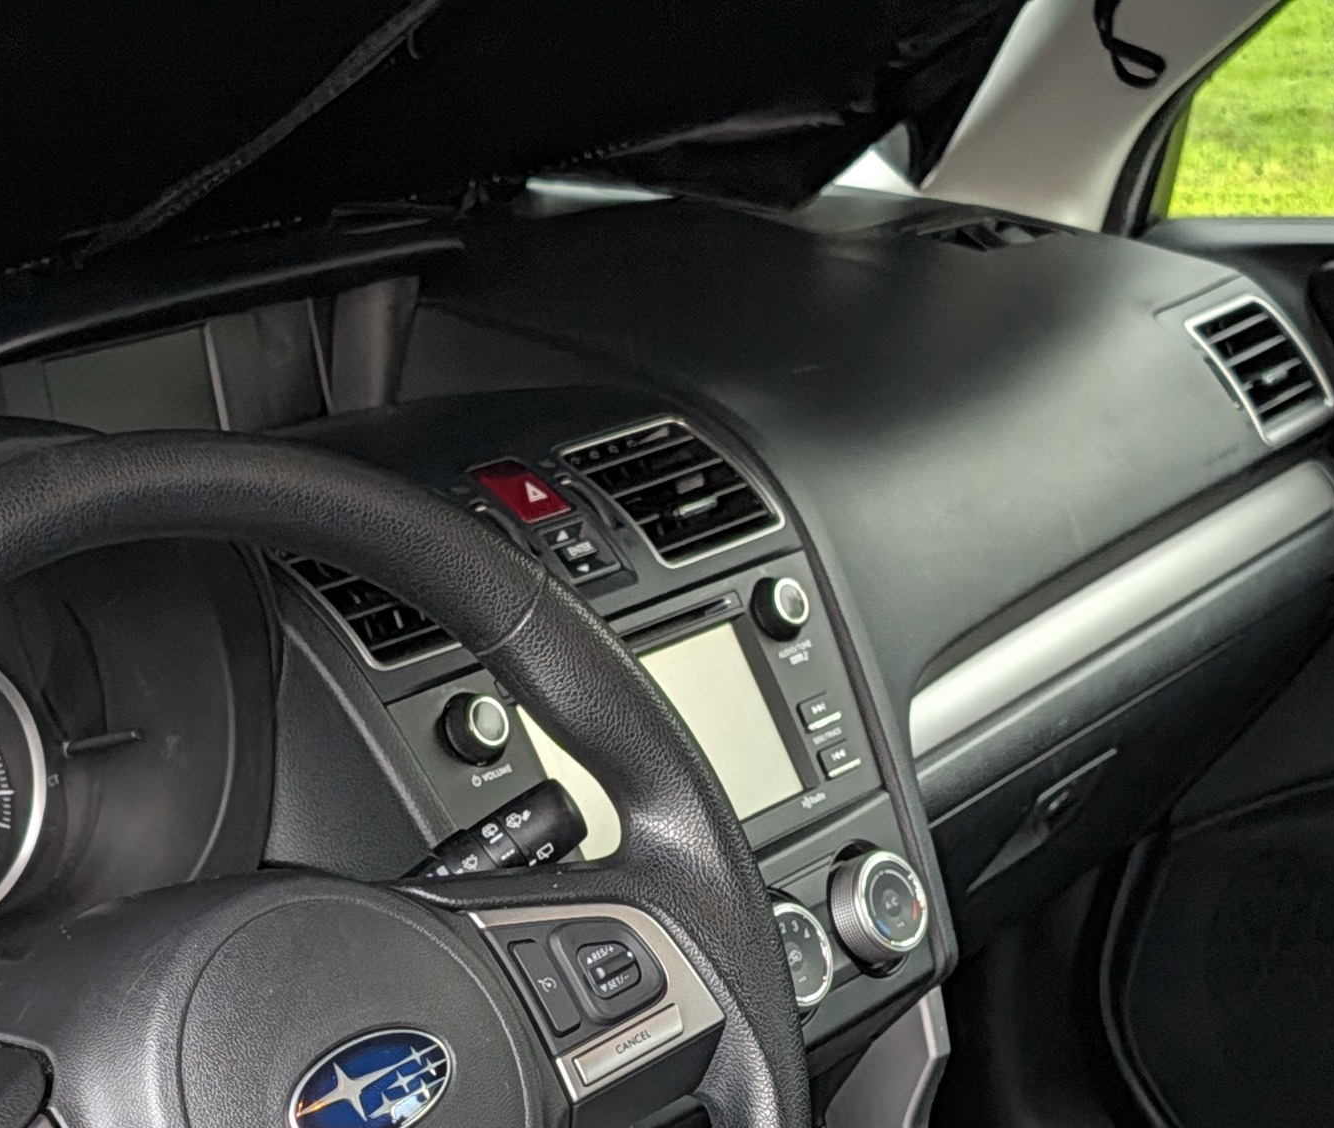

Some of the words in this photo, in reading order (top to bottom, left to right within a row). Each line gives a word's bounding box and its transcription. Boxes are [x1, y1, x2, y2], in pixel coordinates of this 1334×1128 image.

[481, 763, 513, 782] VOLUME
[791, 920, 799, 932] 3
[615, 1029, 652, 1055] CANCEL
